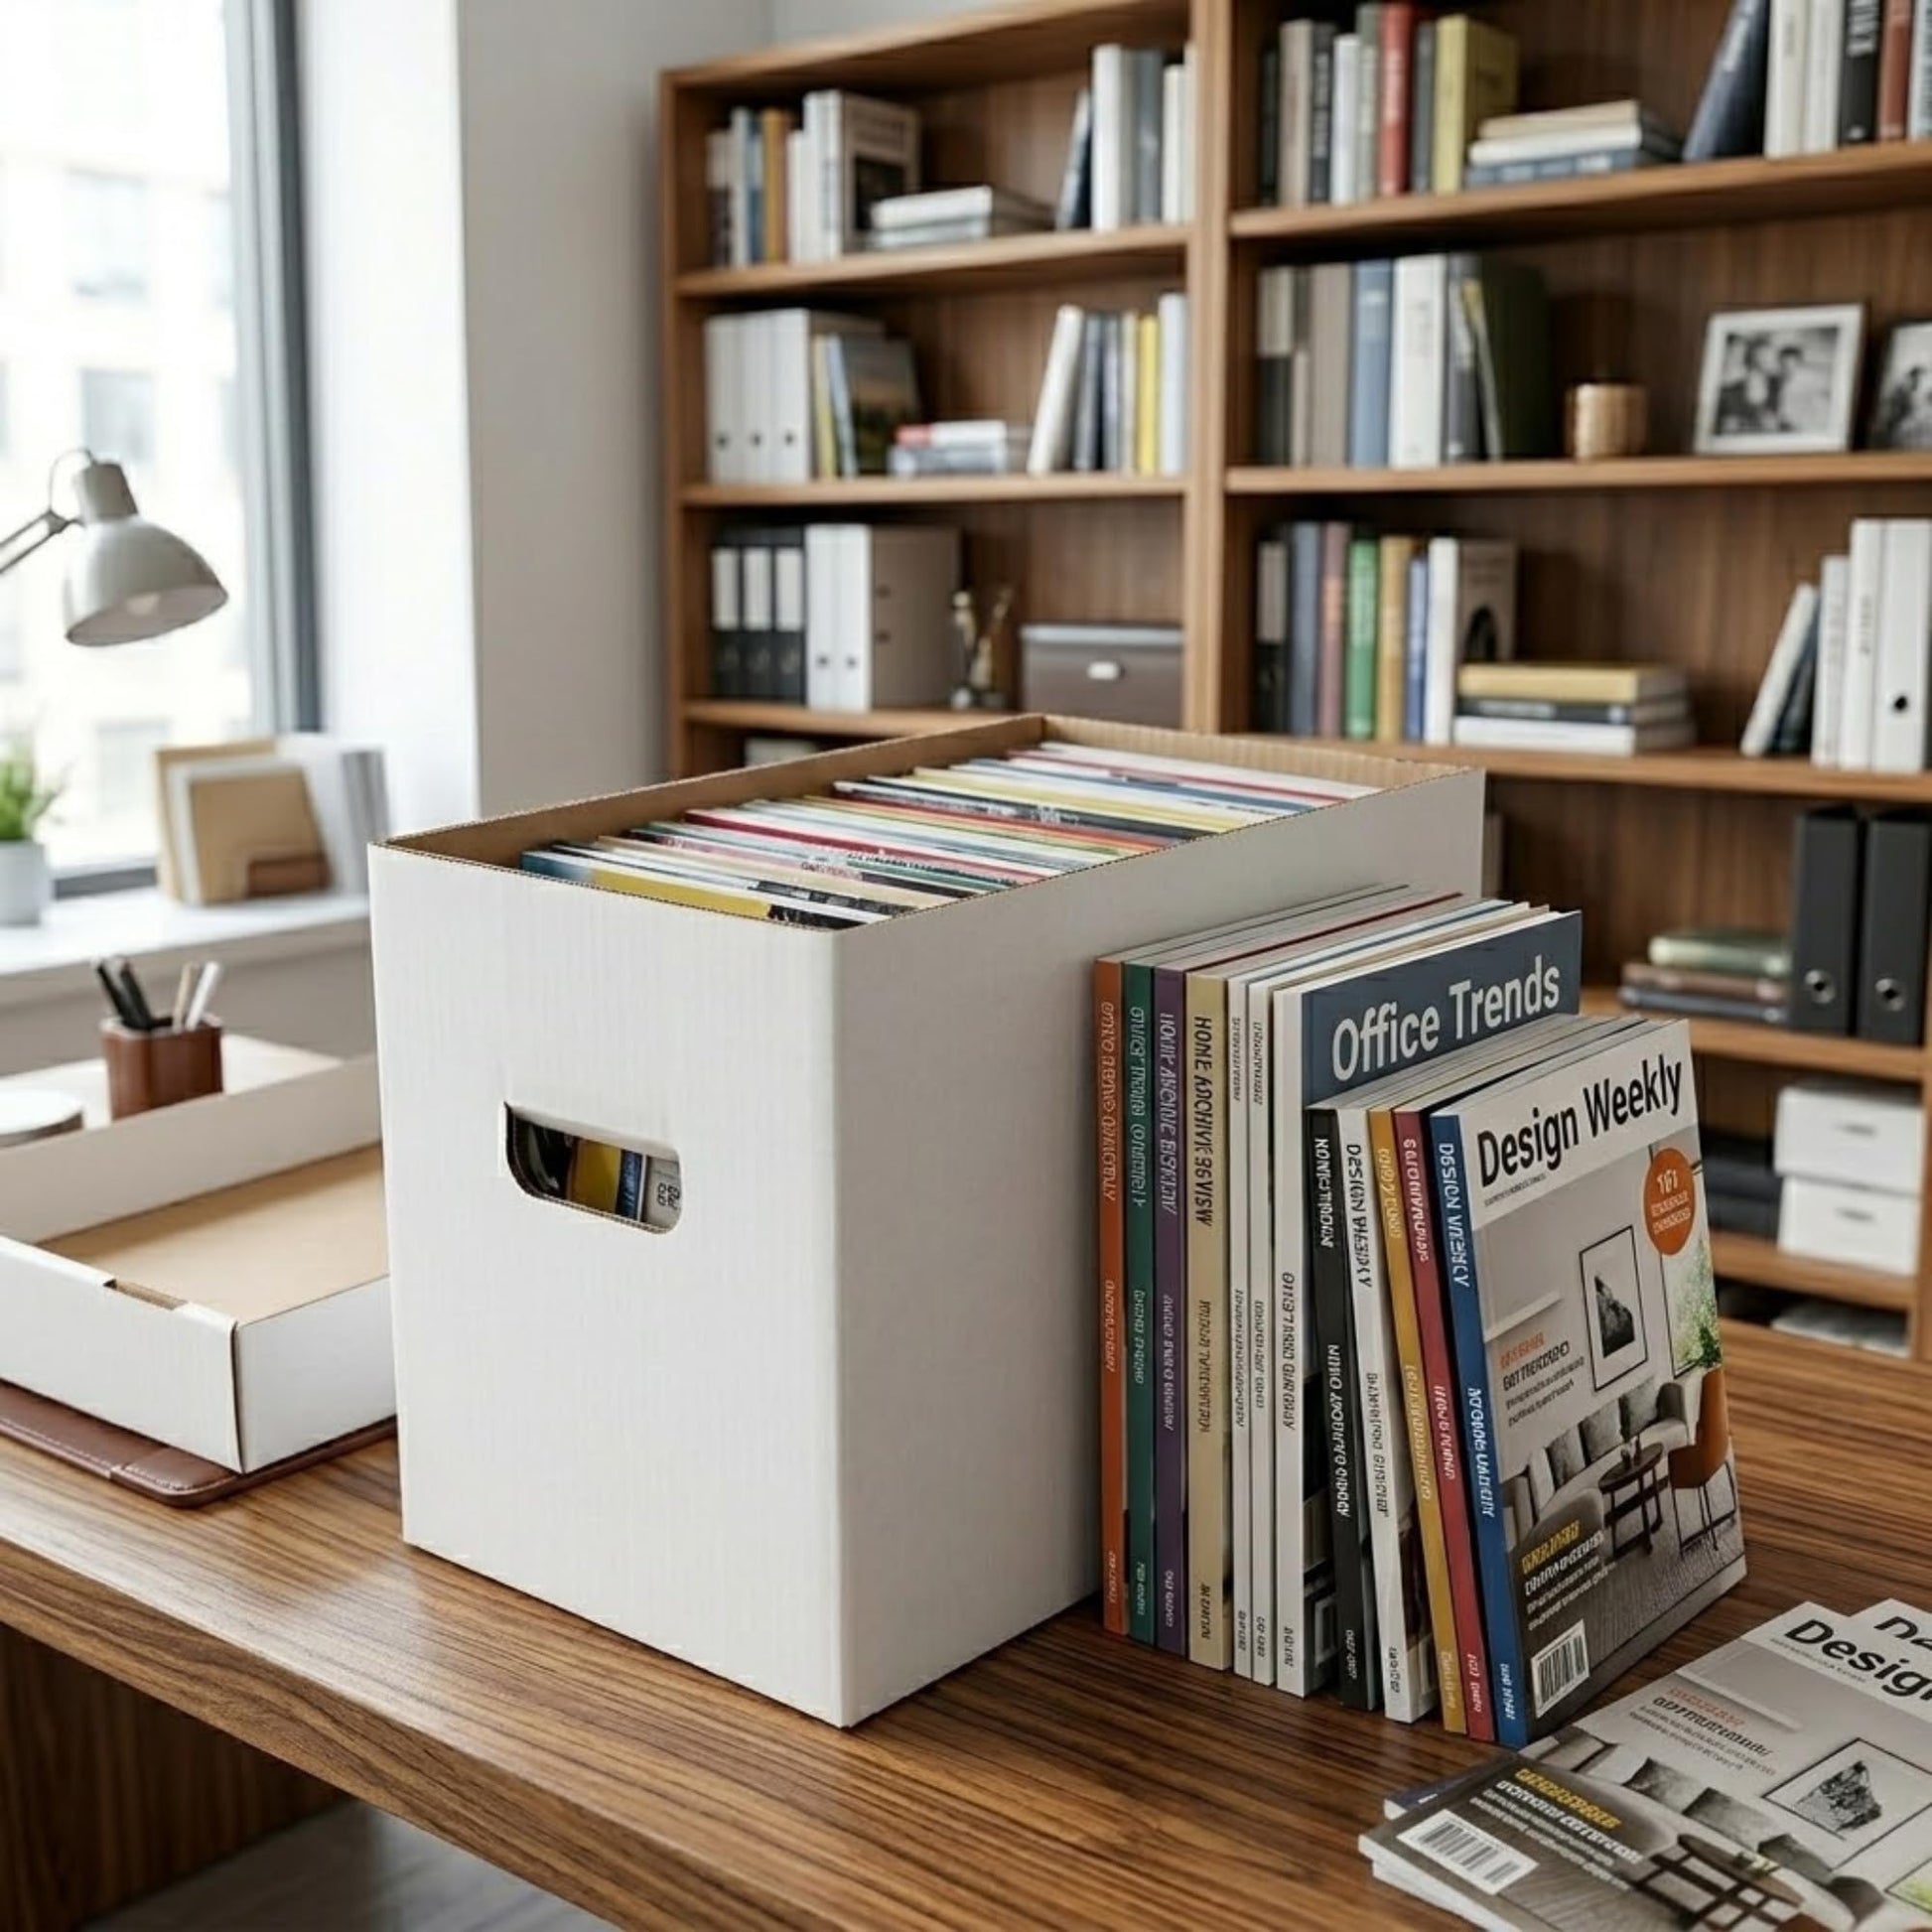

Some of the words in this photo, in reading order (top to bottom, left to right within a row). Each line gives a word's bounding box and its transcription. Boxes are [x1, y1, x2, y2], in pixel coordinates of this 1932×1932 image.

[1331, 1001, 1441, 1082] Office
[1449, 954, 1561, 1042] Trends
[1476, 1106, 1580, 1187] Design
[1583, 1054, 1682, 1139] Weekly
